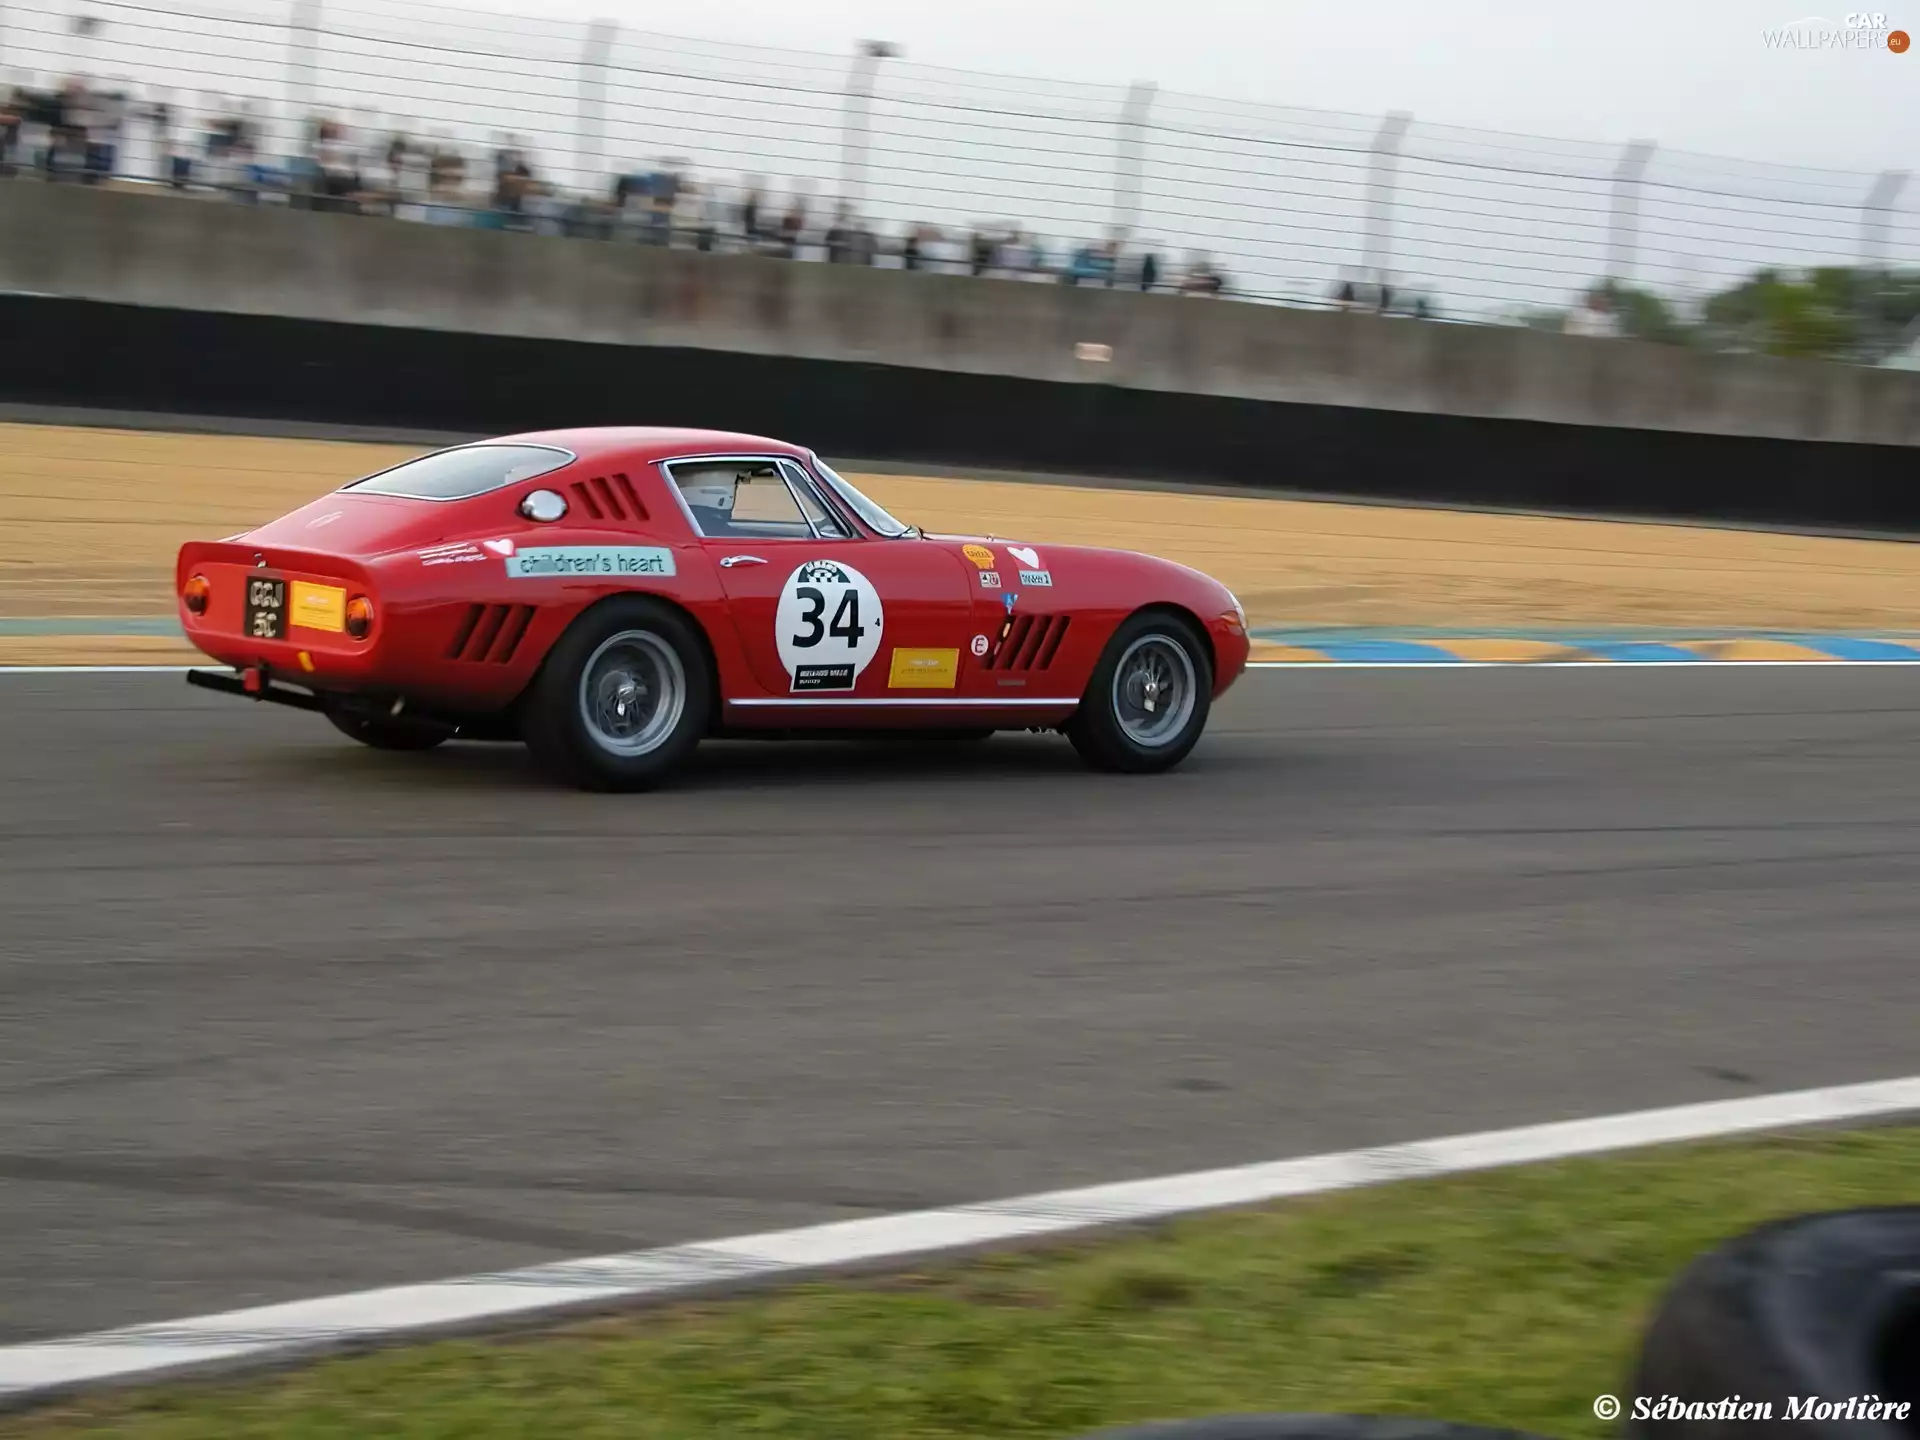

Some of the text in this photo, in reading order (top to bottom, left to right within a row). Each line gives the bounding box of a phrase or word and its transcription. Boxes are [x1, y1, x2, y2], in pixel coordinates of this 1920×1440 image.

[618, 554, 666, 573] heart
[792, 587, 864, 648] 34
[974, 638, 985, 653] E
